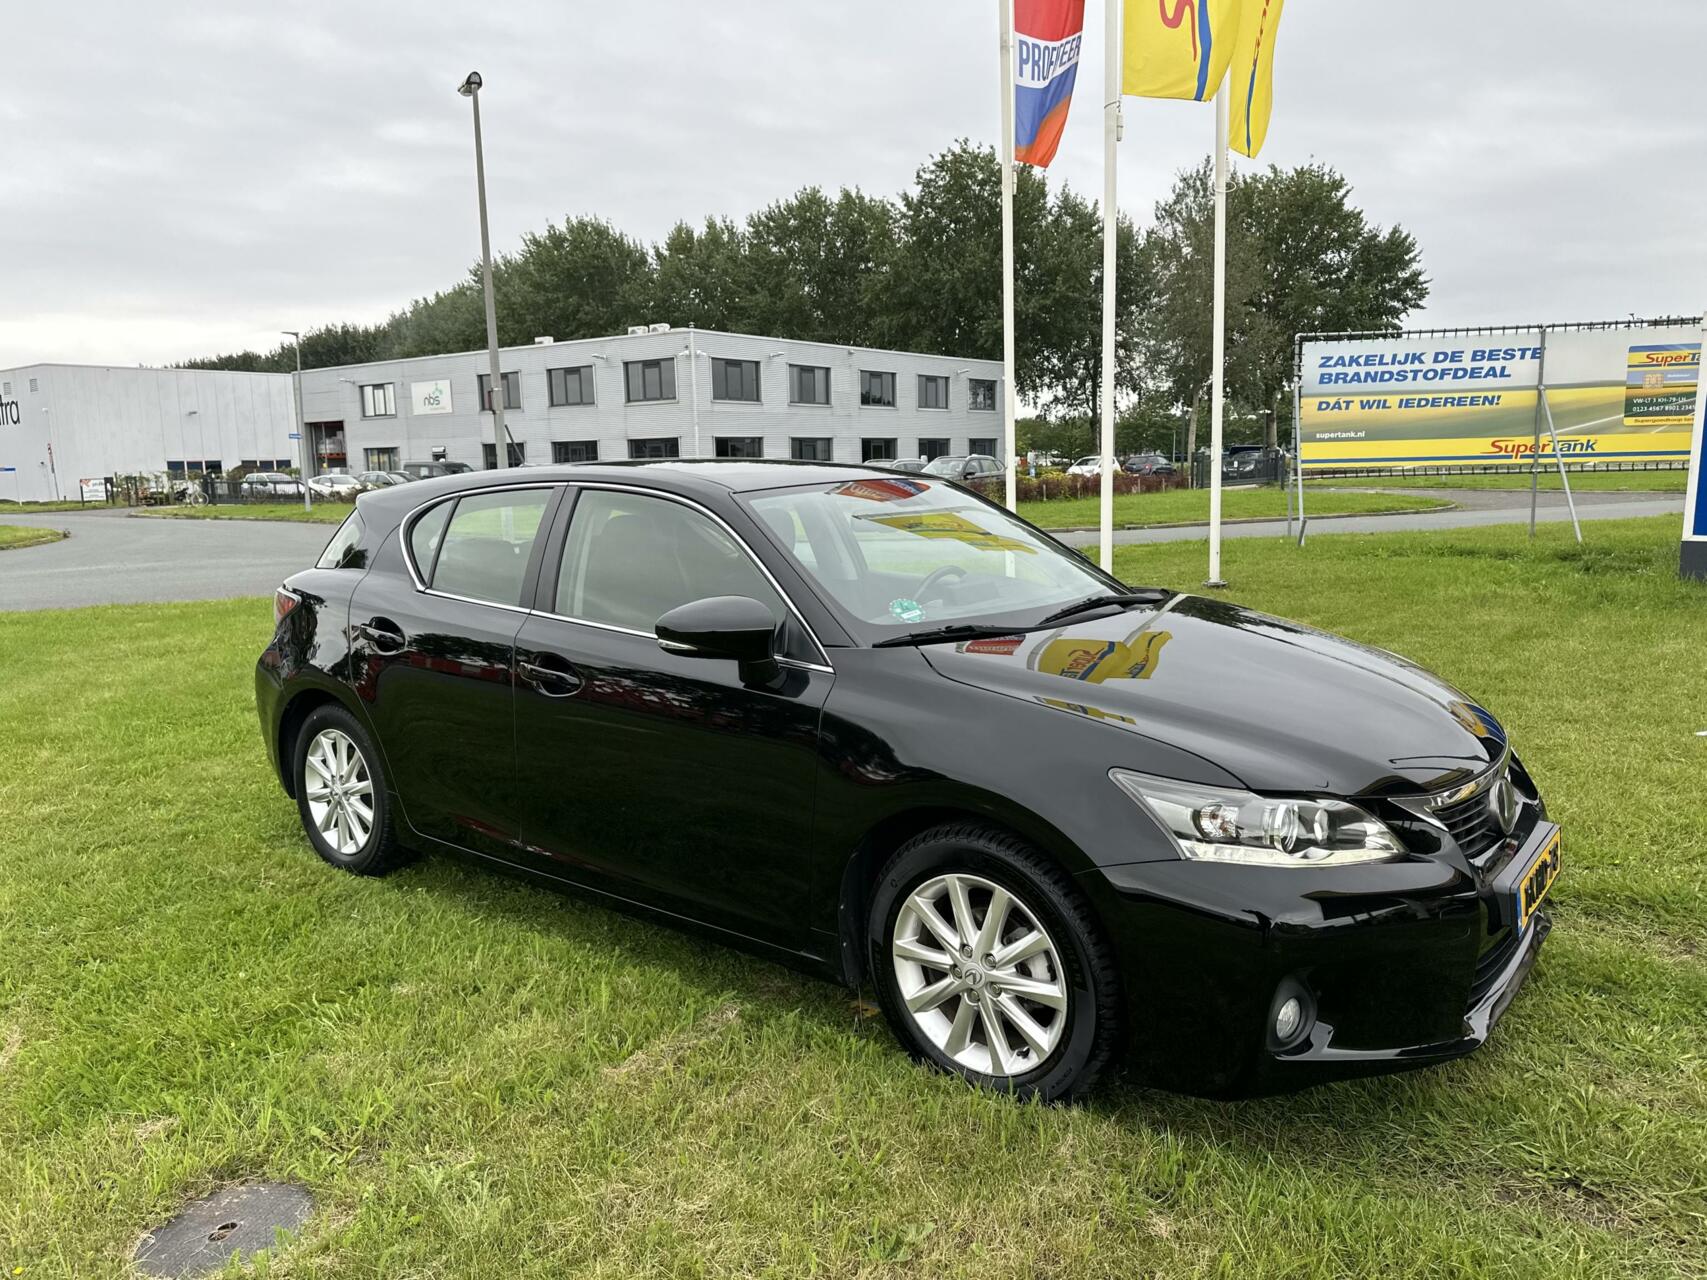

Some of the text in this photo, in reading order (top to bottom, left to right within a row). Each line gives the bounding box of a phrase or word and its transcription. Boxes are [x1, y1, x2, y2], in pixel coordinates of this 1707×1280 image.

[1318, 346, 1541, 369] ZAKELIJK DE BESTE
[1318, 365, 1512, 385] BRANDSTOFDEAL
[423, 393, 441, 407] nbs
[1317, 395, 1502, 411] DÁT WIL IEDEREEN!
[1316, 431, 1366, 439] supertank.nl
[1480, 439, 1596, 459] SuperTank
